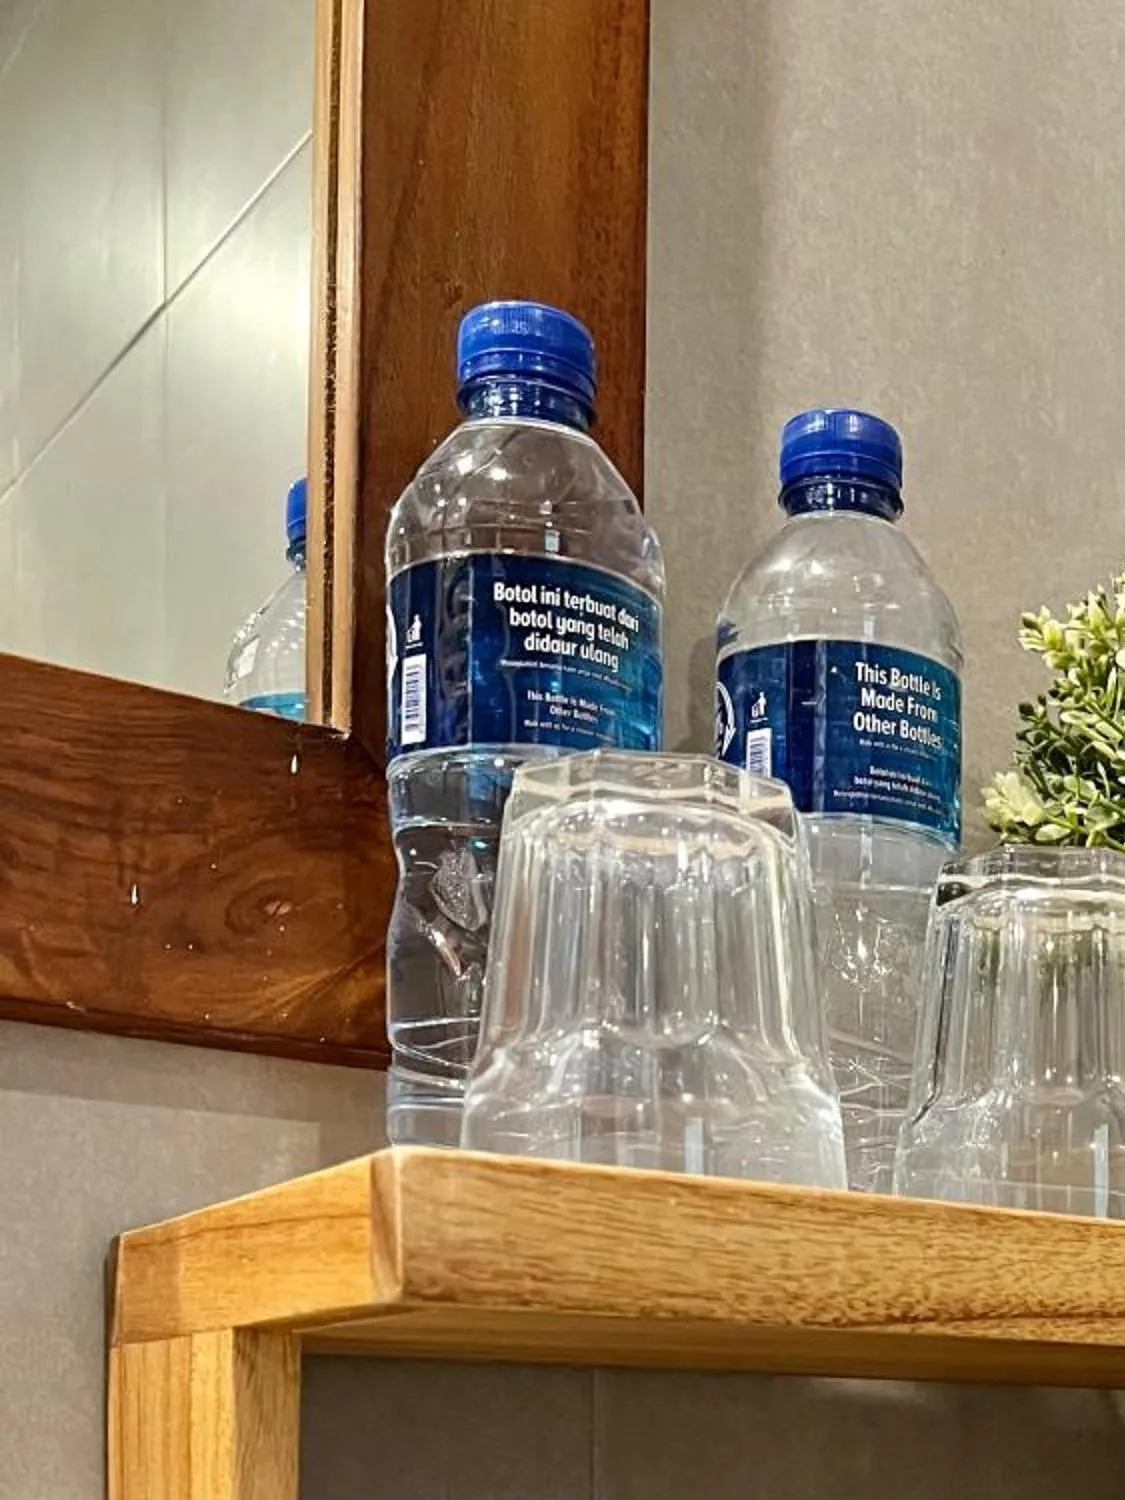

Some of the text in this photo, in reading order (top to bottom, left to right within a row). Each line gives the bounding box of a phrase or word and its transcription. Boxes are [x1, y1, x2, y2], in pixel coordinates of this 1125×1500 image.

[493, 581, 639, 632] Botol ini terbuat dari
[509, 607, 629, 650] botol yang telah
[524, 634, 619, 672] didaur ulang
[854, 661, 941, 700] This Bottle Is
[861, 687, 937, 723] Made From
[853, 711, 942, 749] Other Bottles
